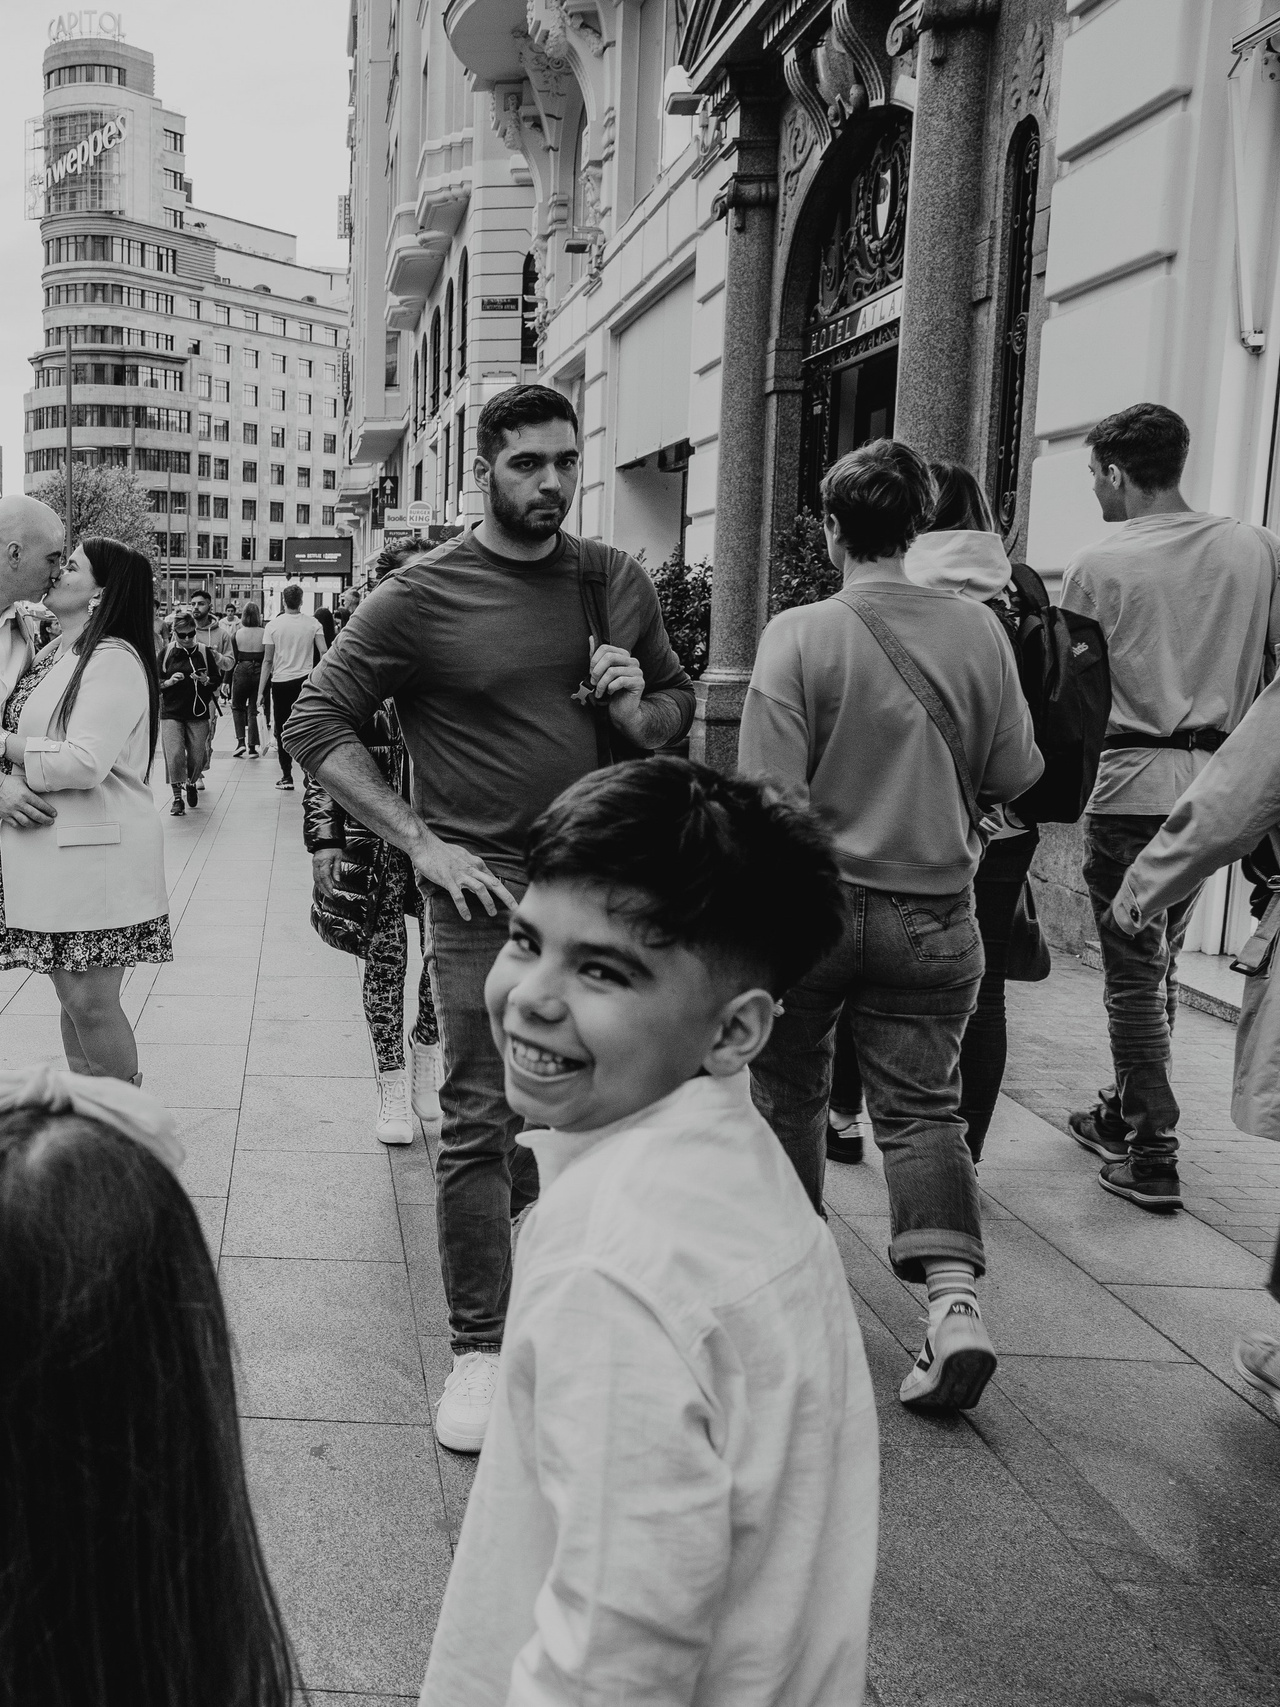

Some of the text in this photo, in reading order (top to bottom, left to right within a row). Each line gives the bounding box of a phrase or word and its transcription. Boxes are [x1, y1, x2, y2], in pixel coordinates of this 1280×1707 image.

[48, 10, 126, 40] CAPITOL
[809, 294, 897, 355] HOTEL ATLA
